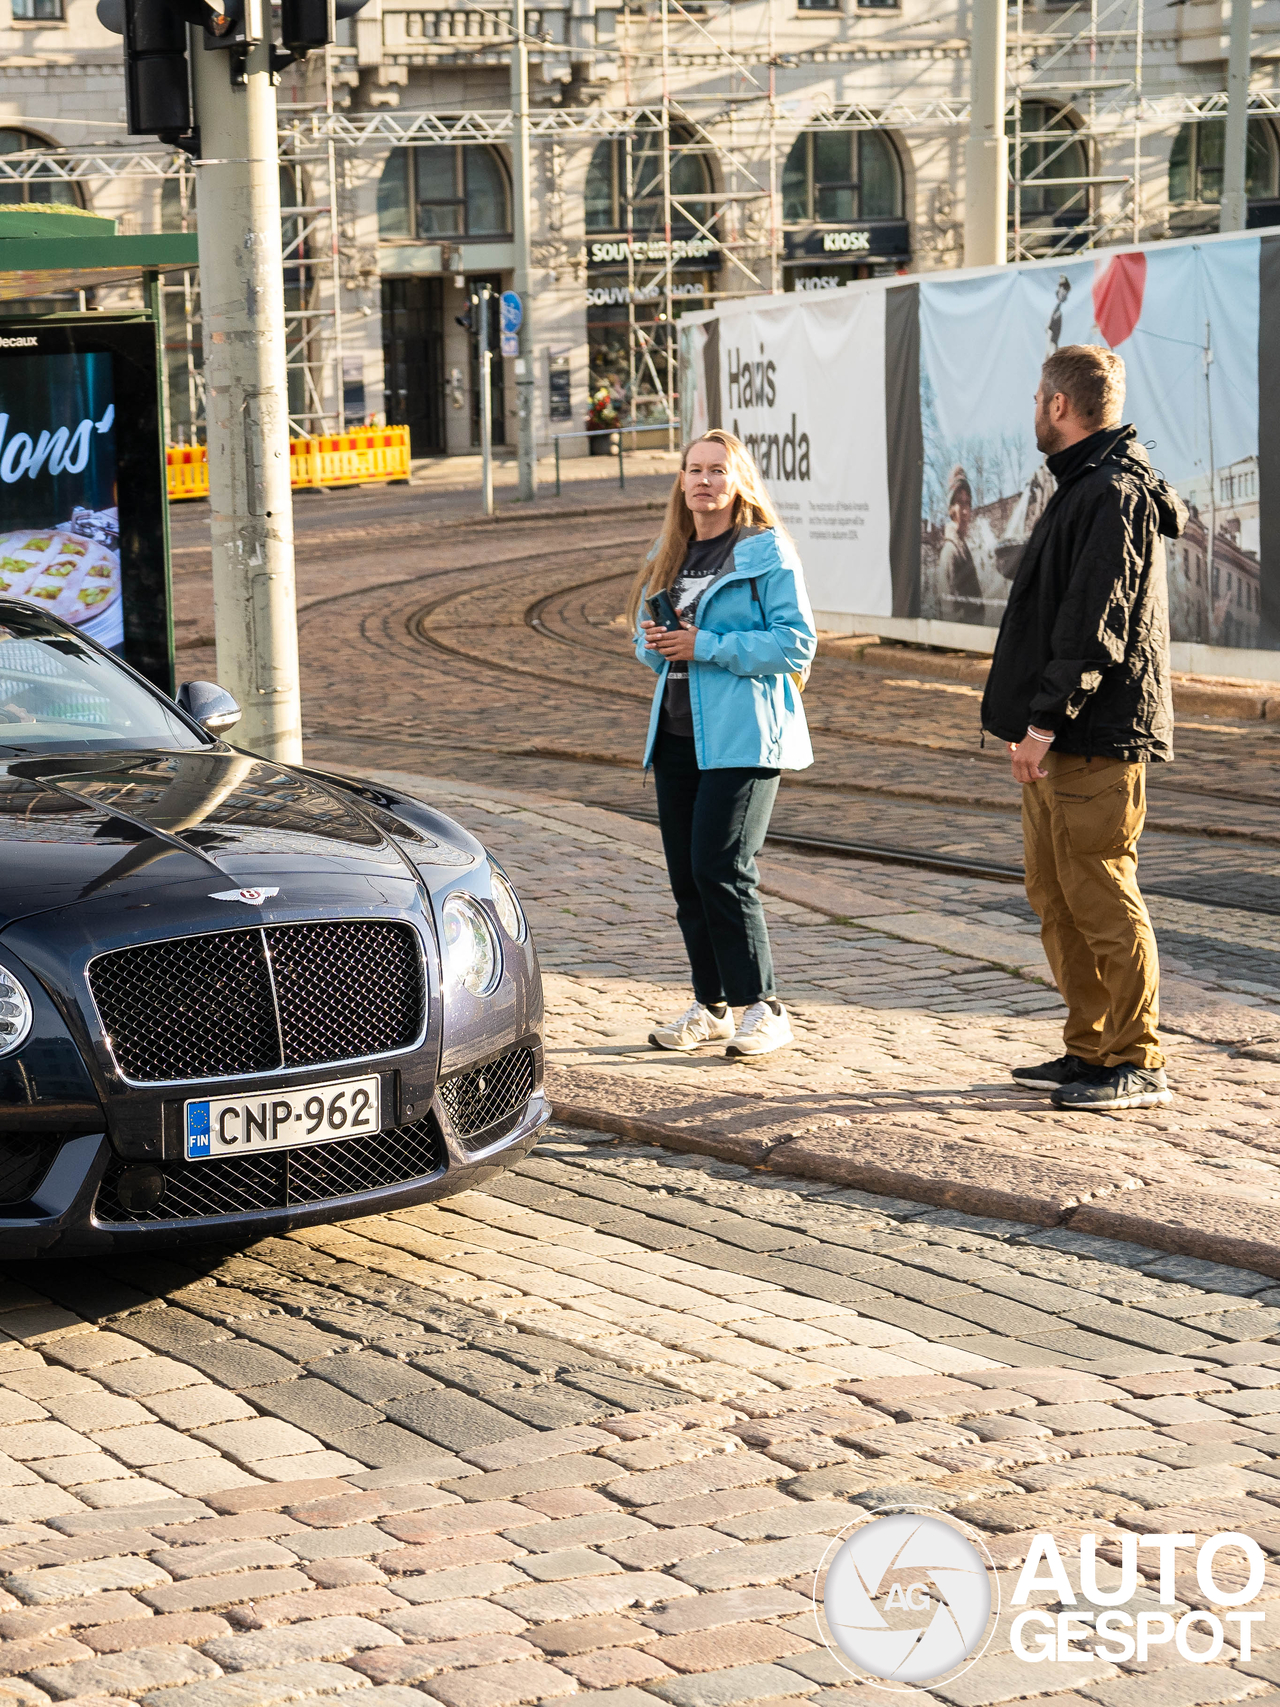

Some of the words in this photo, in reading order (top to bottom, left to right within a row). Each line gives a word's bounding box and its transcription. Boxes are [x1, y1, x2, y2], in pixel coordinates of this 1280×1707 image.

[823, 231, 871, 252] KIOSK
[794, 275, 840, 292] KIOSK
[727, 341, 777, 409] Havis
[218, 1087, 370, 1146] CNP-962
[190, 1134, 209, 1148] FIN
